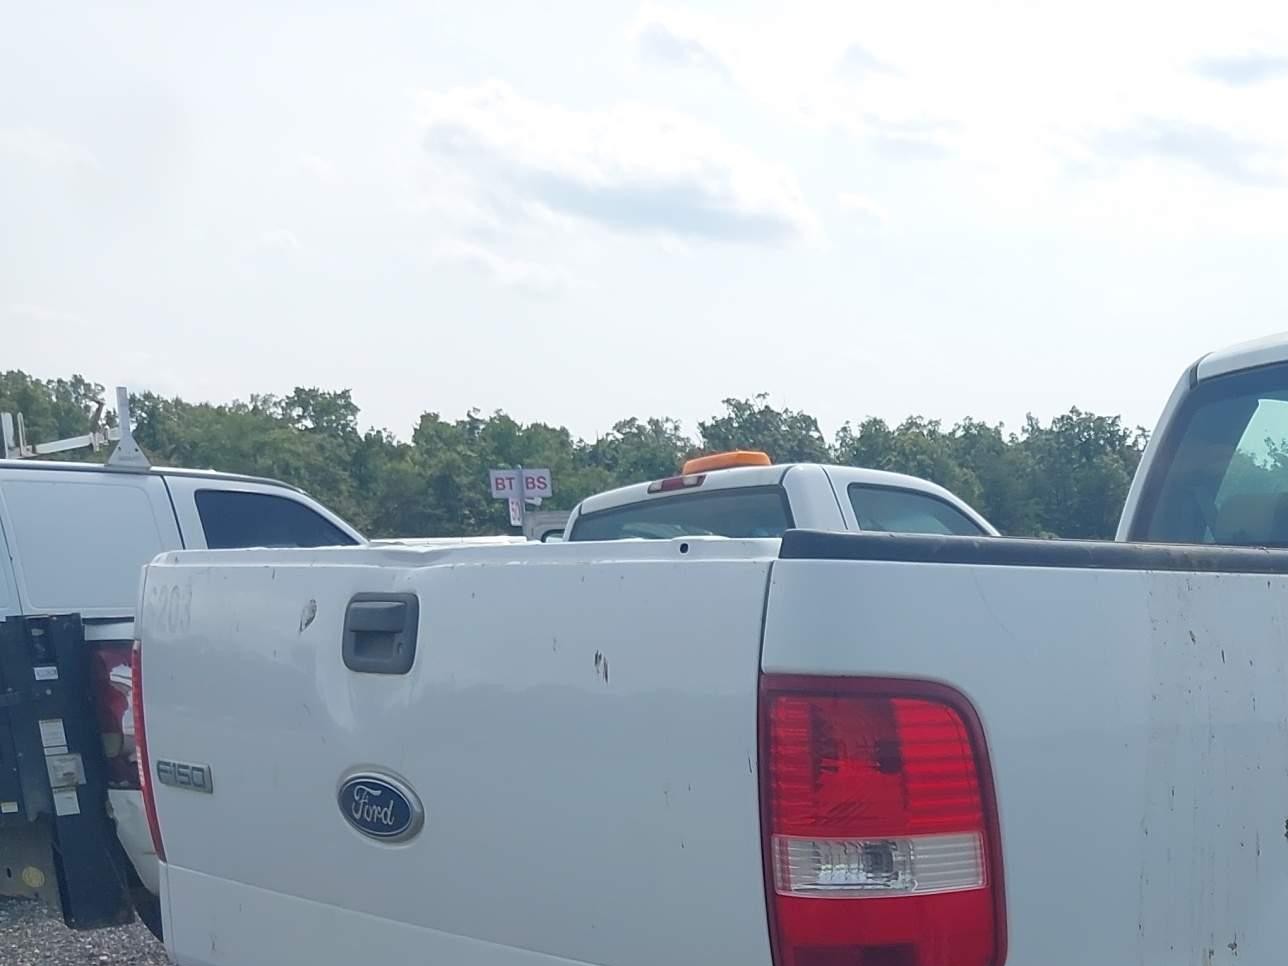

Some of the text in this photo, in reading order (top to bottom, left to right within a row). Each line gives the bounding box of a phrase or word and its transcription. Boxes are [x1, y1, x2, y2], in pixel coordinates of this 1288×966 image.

[495, 475, 548, 491] BT BS
[351, 784, 395, 826] Ford
